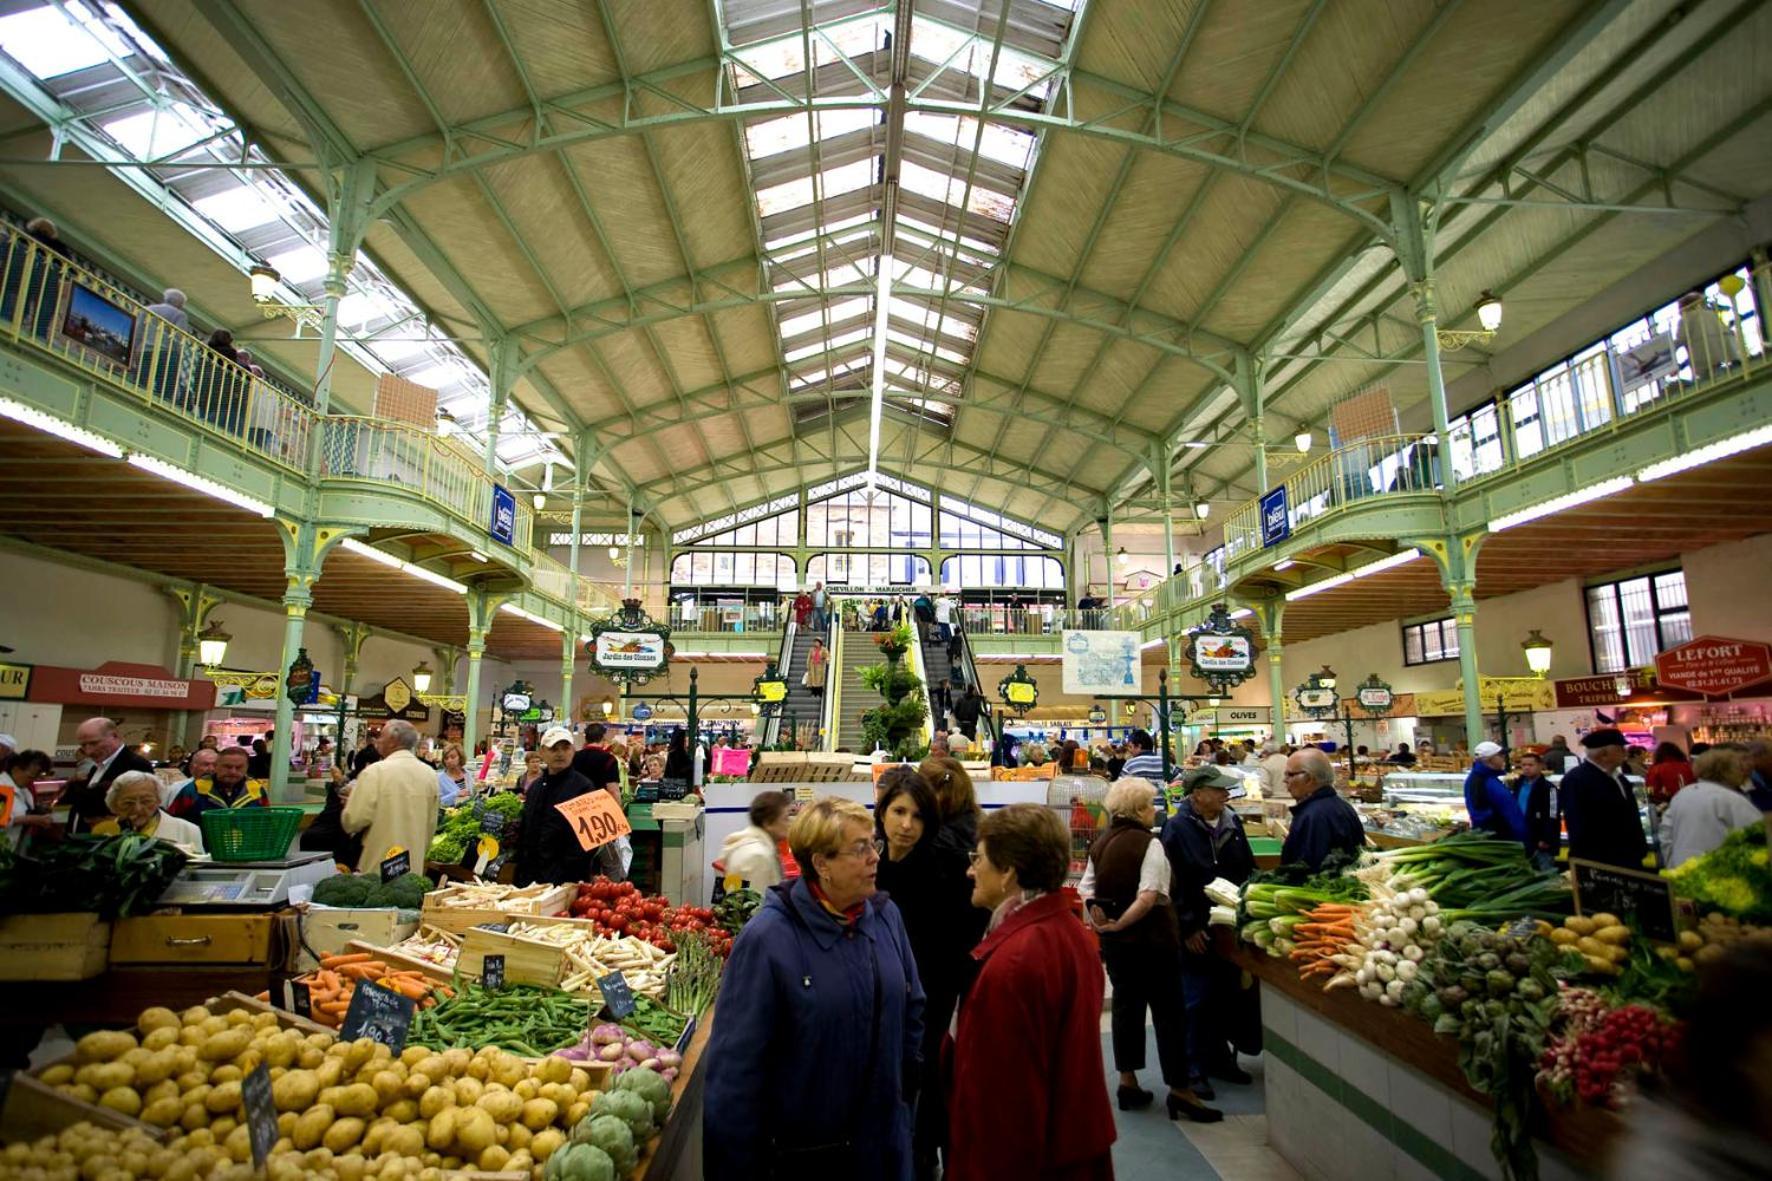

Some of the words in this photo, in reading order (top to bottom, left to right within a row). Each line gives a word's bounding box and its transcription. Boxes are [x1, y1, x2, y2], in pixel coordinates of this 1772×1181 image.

[1676, 644, 1743, 662] LEFORT
[82, 676, 144, 688] COUSCOUS
[147, 680, 188, 691] MAISON
[1230, 711, 1257, 719] OLIVES
[578, 812, 617, 843] 1,90
